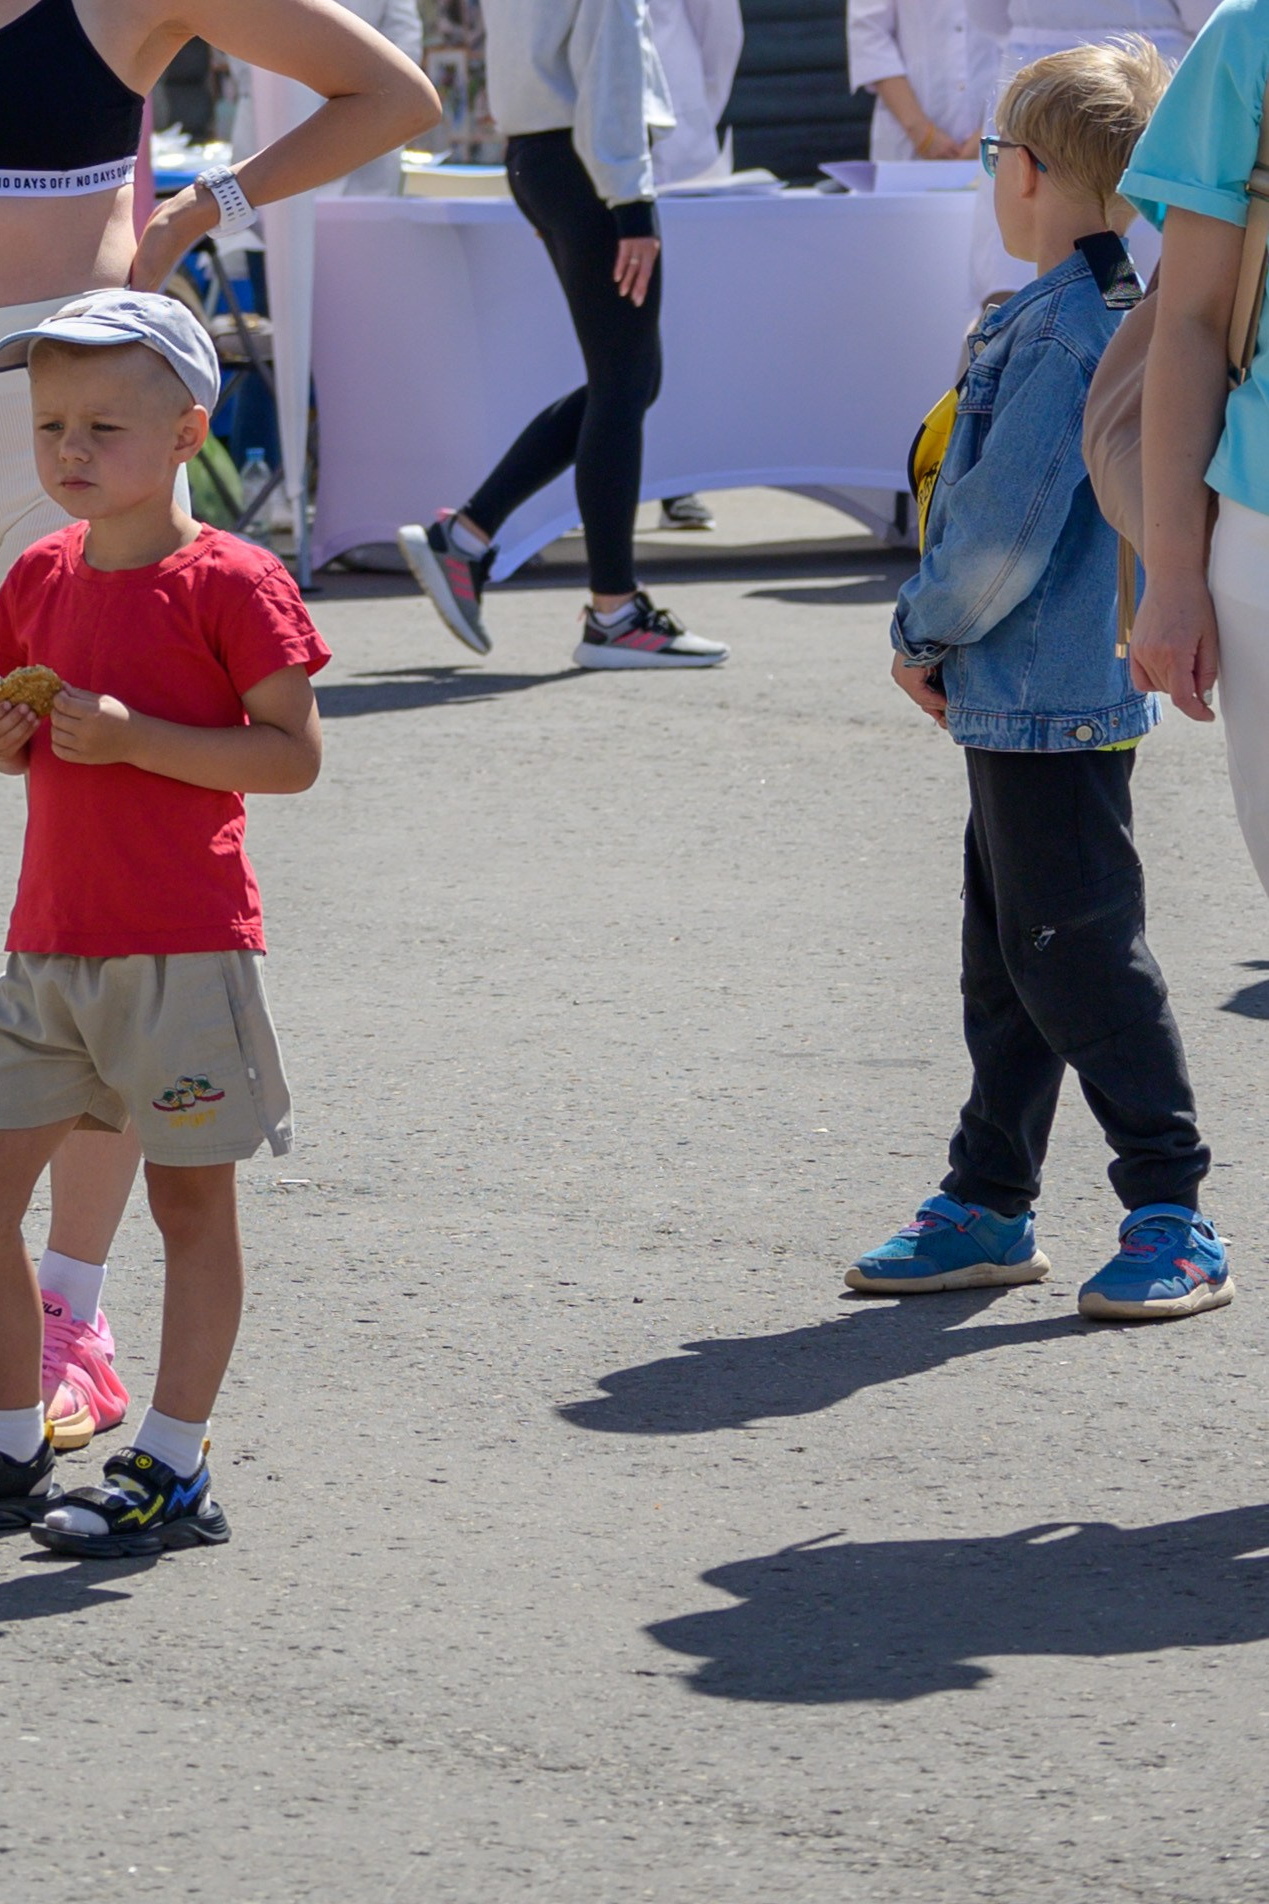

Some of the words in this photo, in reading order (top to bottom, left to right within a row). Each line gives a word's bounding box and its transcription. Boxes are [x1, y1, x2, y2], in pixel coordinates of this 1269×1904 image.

[14, 177, 46, 189] DAYS
[50, 177, 71, 189] OFF
[76, 175, 90, 187] NO
[93, 169, 115, 184] DAYS
[42, 1301, 63, 1318] ILA
